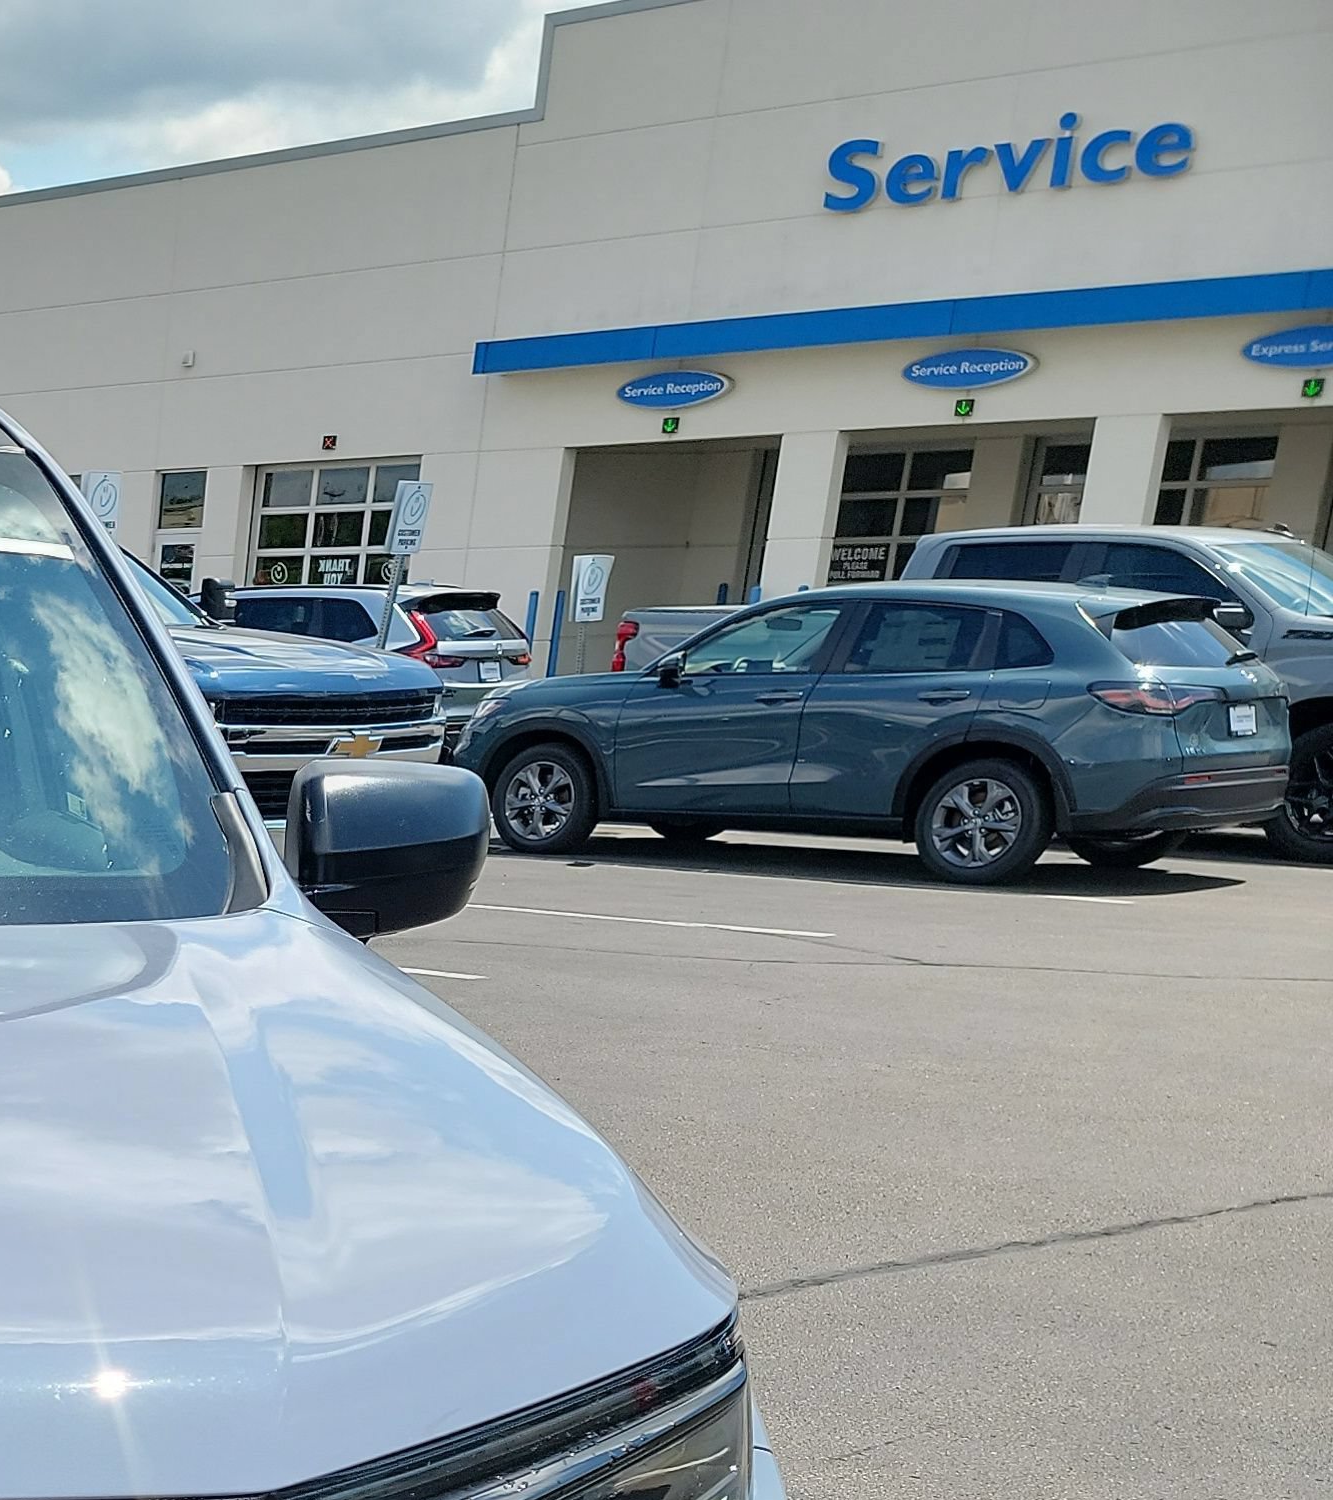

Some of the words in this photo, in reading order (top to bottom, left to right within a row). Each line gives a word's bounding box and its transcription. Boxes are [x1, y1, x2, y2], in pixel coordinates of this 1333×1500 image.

[823, 112, 1196, 213] Service
[1251, 344, 1305, 357] Express
[911, 363, 957, 377] Service
[959, 359, 1024, 375] Reception
[624, 384, 664, 397] Service
[666, 380, 721, 395] Reception
[832, 547, 887, 560] WELCOME
[842, 561, 869, 570] PLEASE
